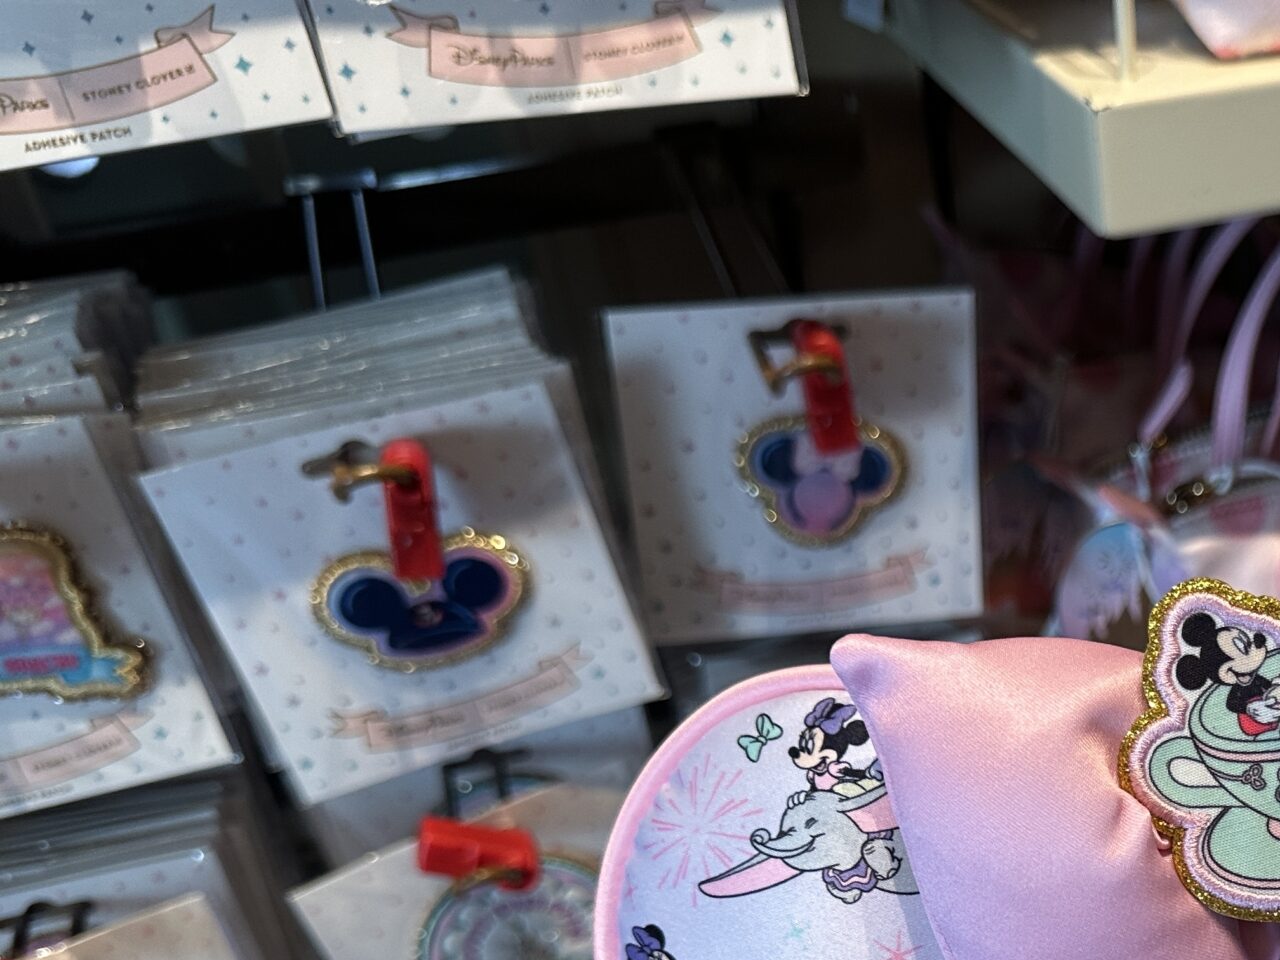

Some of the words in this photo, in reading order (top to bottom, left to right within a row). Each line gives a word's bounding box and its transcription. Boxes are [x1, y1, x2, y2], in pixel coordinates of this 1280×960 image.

[82, 82, 133, 103] STONEY
[135, 68, 184, 92] CLOVER
[24, 133, 88, 153] ADHESIVE
[90, 125, 134, 142] PATCH
